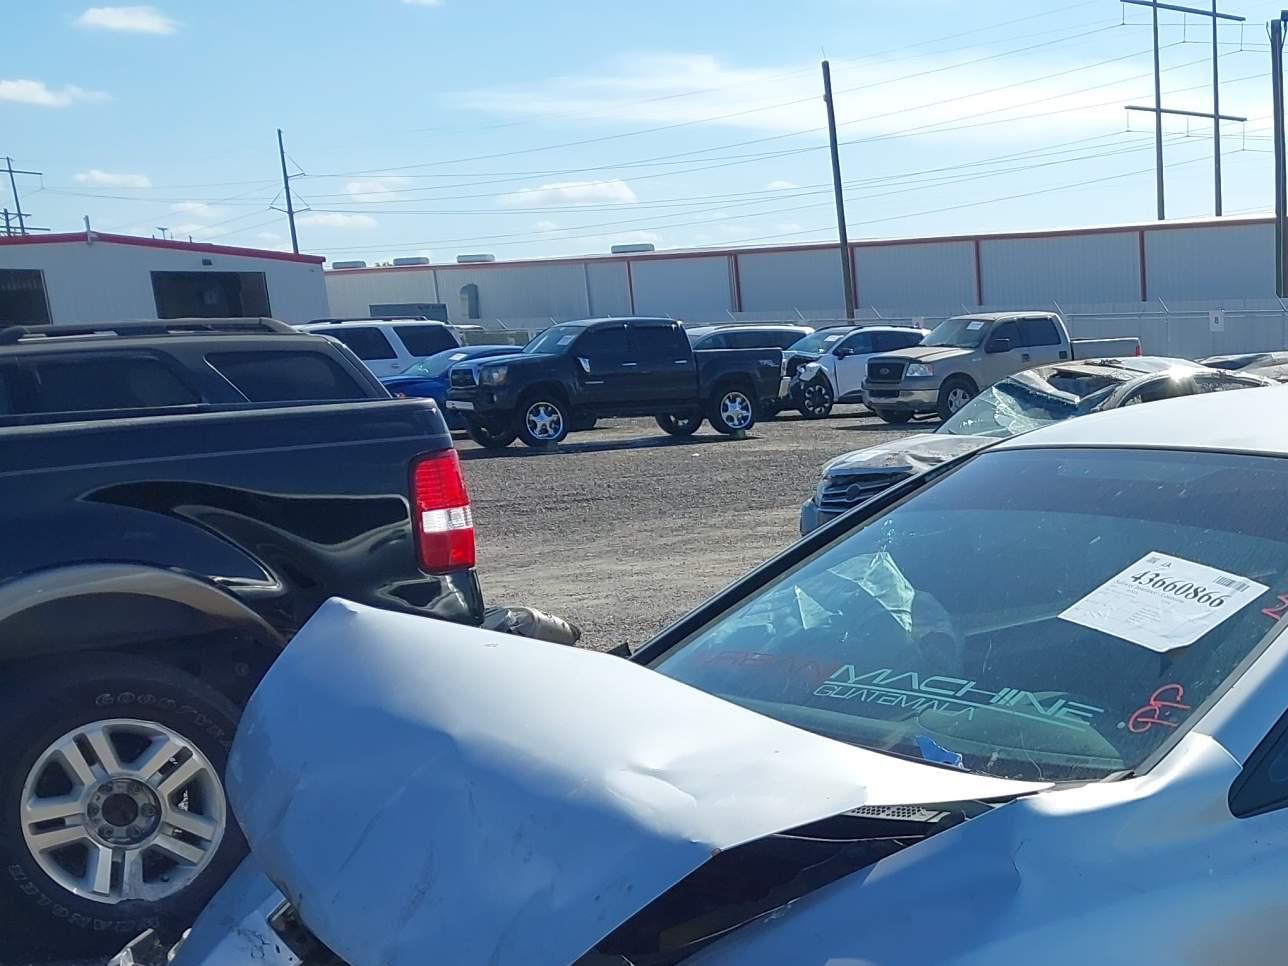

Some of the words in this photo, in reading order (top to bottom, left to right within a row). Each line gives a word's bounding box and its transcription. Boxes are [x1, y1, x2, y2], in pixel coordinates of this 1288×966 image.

[1130, 569, 1233, 608] 43660866
[813, 684, 976, 721] GUATEMALA
[829, 663, 1105, 726] MACHINE
